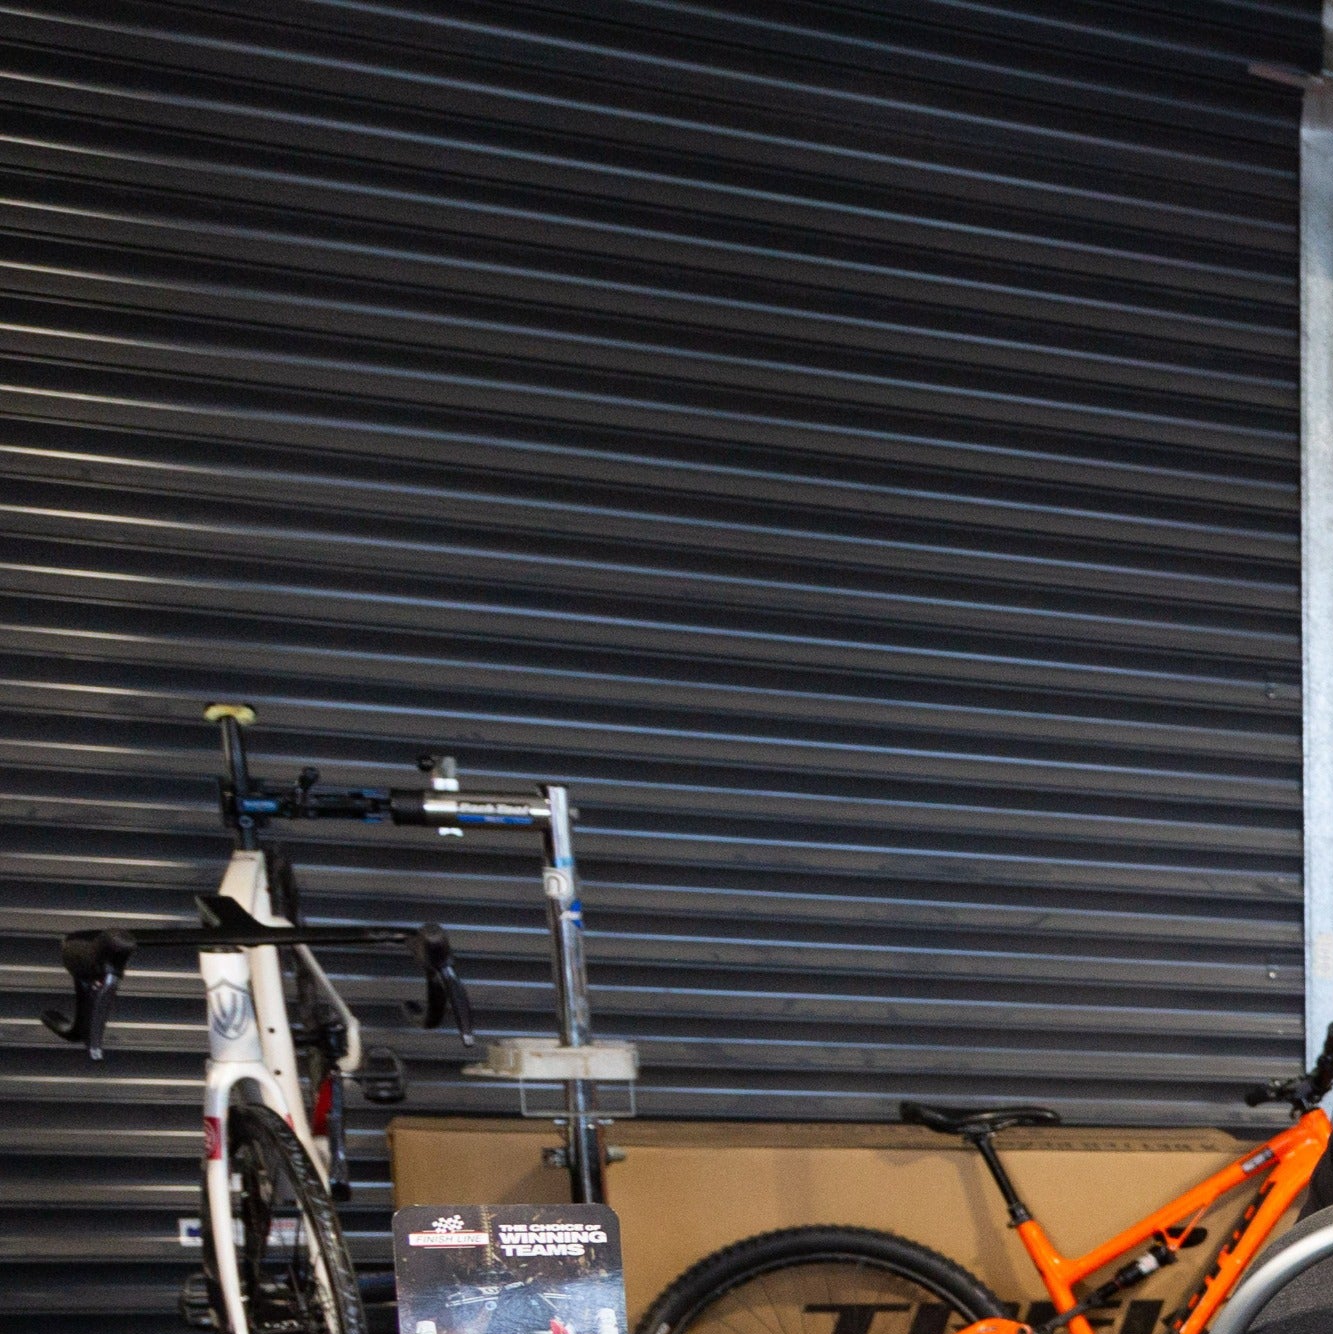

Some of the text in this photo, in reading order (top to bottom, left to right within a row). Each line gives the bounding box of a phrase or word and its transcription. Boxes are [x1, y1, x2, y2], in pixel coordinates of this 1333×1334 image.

[499, 1224, 526, 1232] THE
[528, 1224, 583, 1232] CHOICE
[416, 1235, 481, 1243] FINISH LINE
[499, 1231, 608, 1244] WINNING
[501, 1244, 585, 1257] TEAMS
